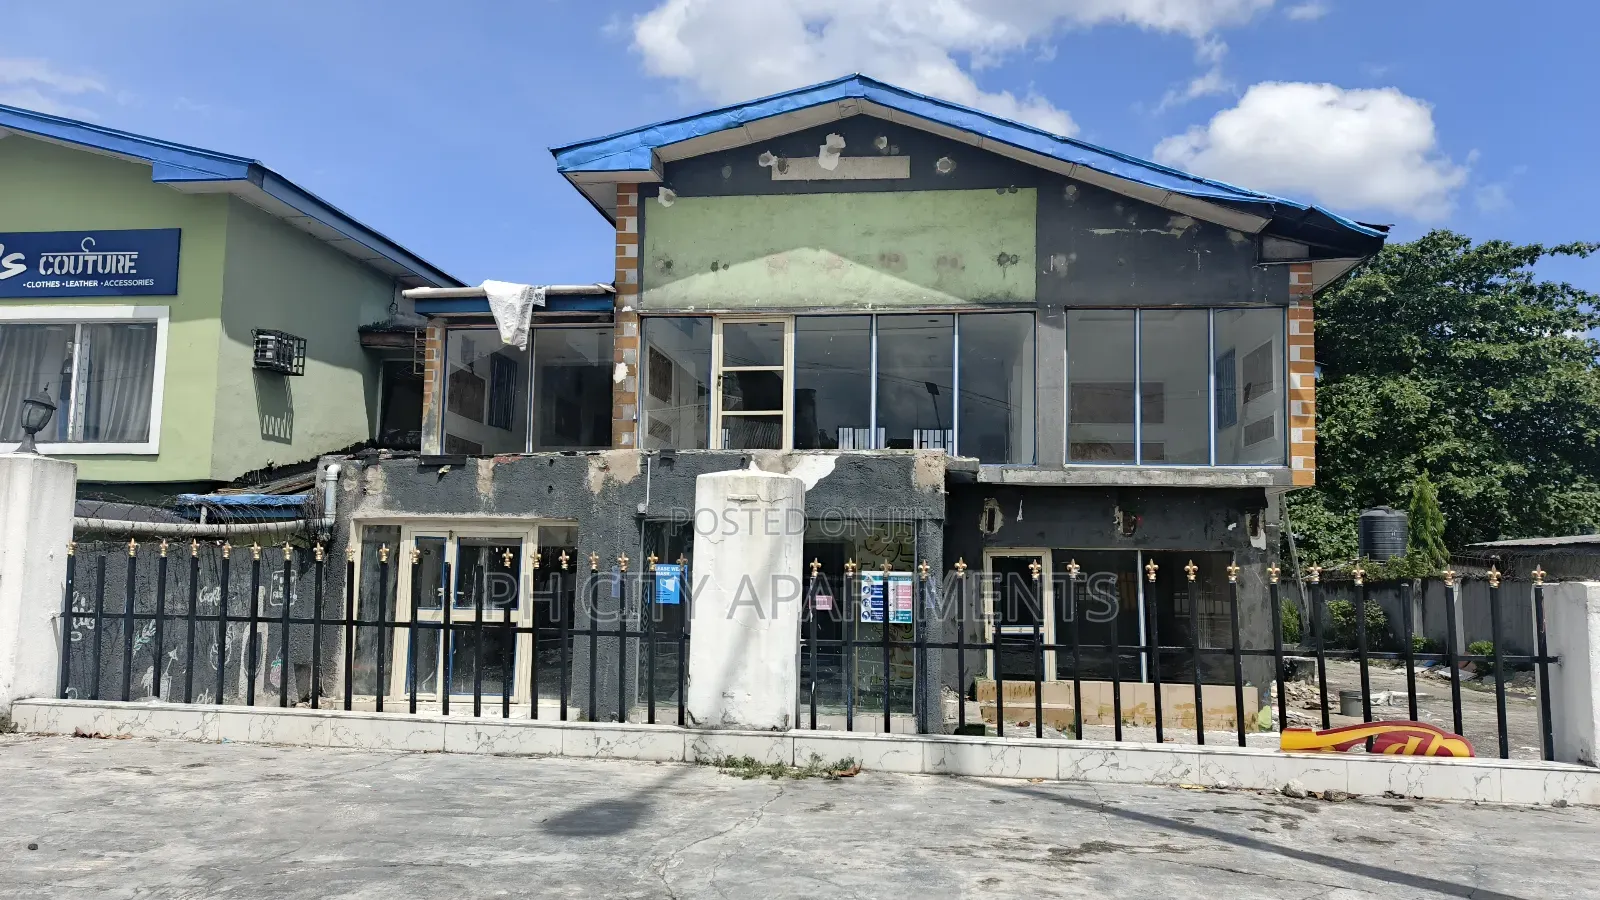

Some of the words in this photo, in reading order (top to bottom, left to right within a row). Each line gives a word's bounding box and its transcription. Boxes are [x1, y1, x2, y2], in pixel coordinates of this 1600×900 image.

[39, 254, 138, 275] COUTURE
[27, 280, 60, 288] CLOTHES
[104, 279, 154, 287] ACCESSORIES
